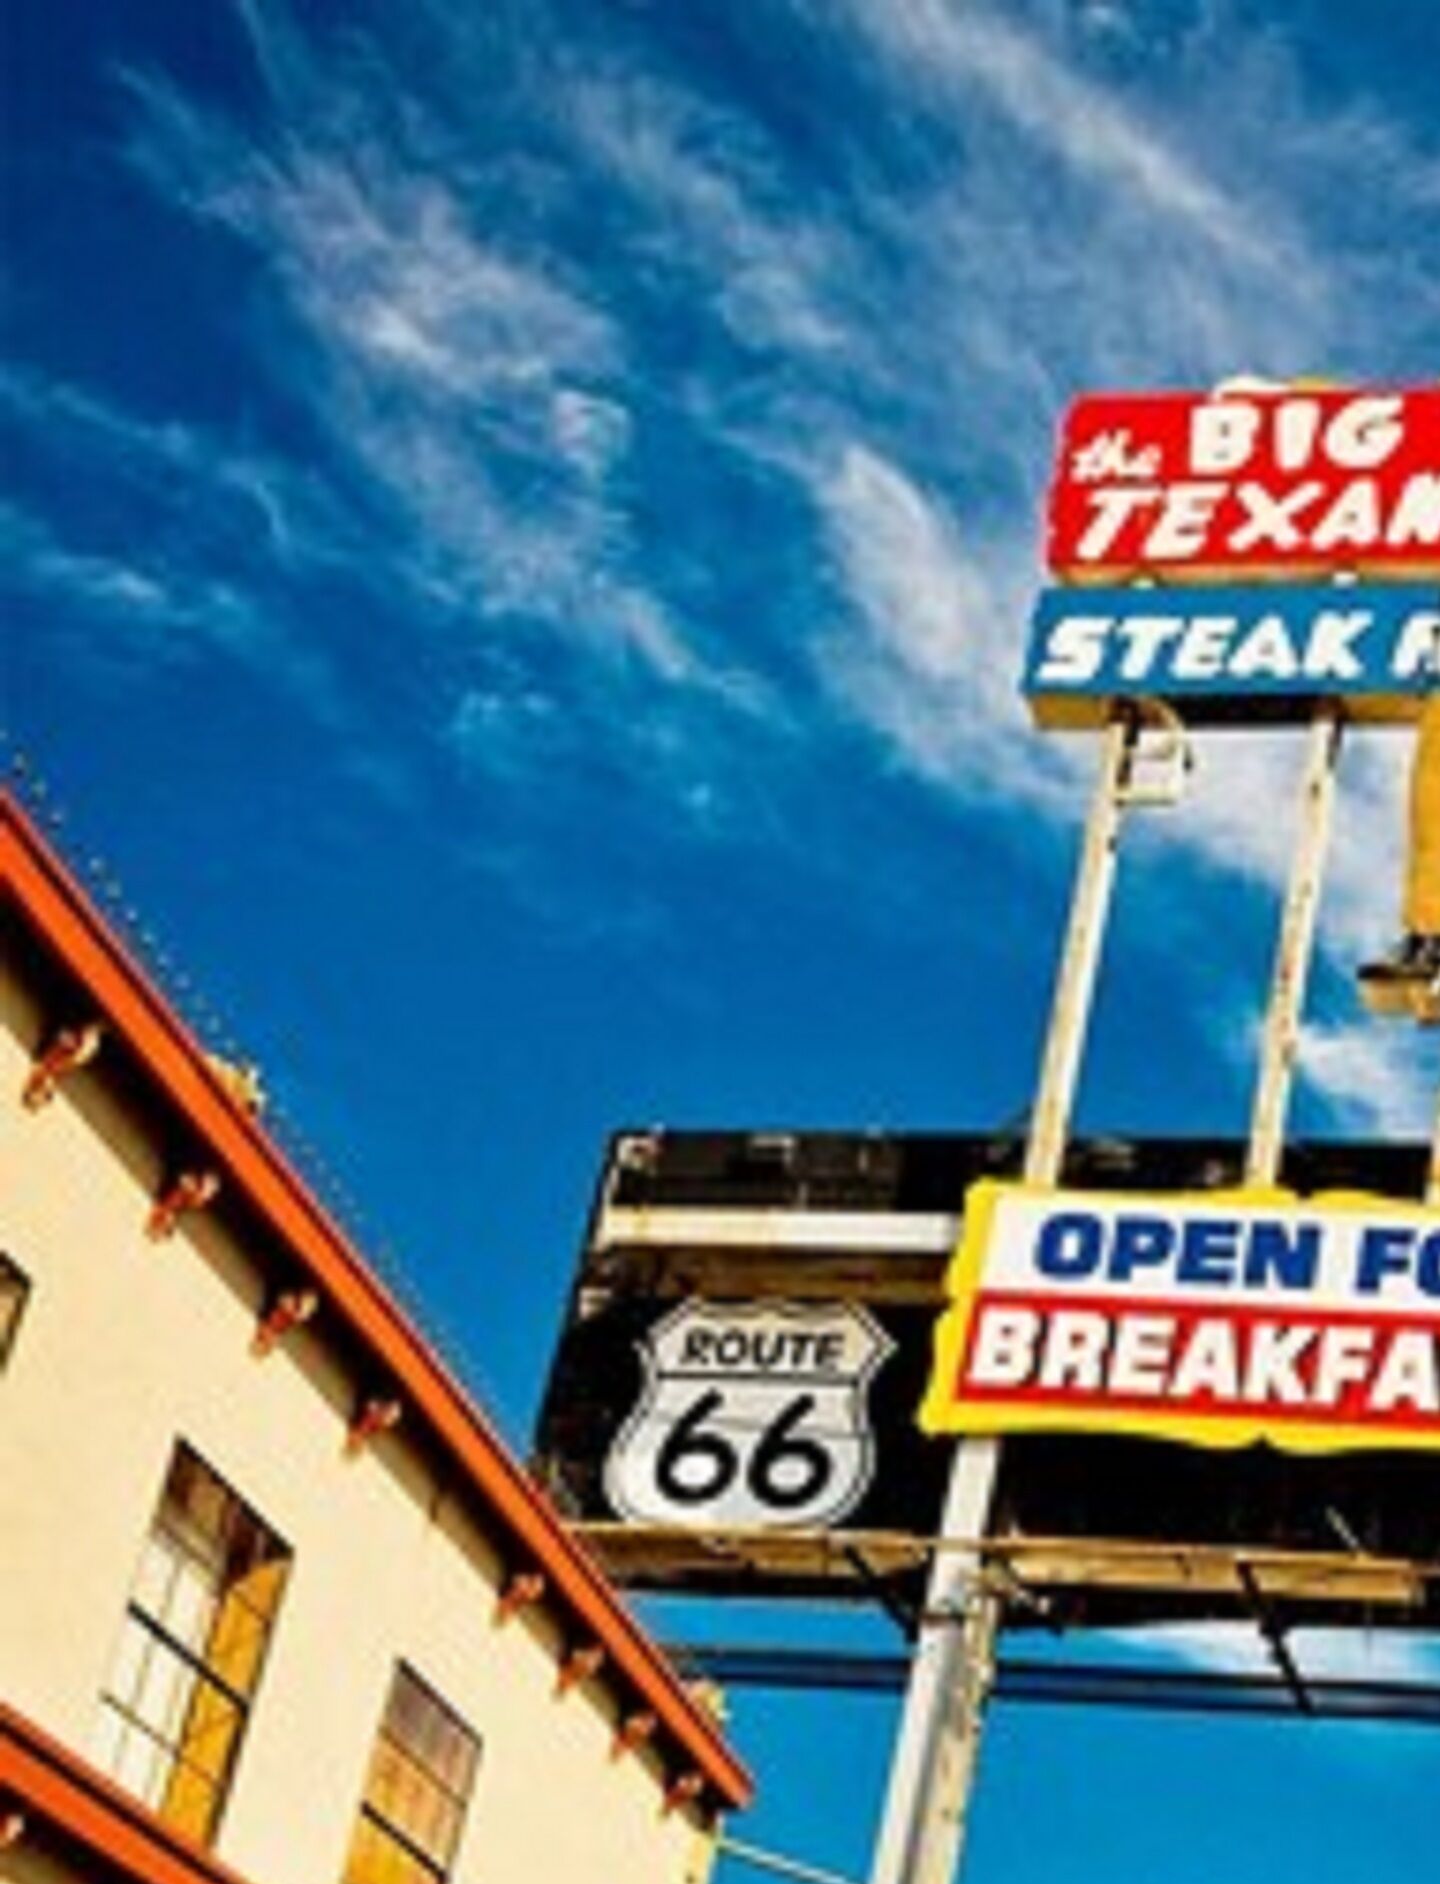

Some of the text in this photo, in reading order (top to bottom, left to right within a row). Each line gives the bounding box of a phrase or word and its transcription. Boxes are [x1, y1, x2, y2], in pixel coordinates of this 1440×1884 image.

[1072, 397, 1405, 480] the BIG
[1036, 612, 1375, 681] STEAK
[1034, 1212, 1322, 1292] OPEN
[681, 1328, 845, 1366] ROUTE
[655, 1388, 832, 1509] 66
